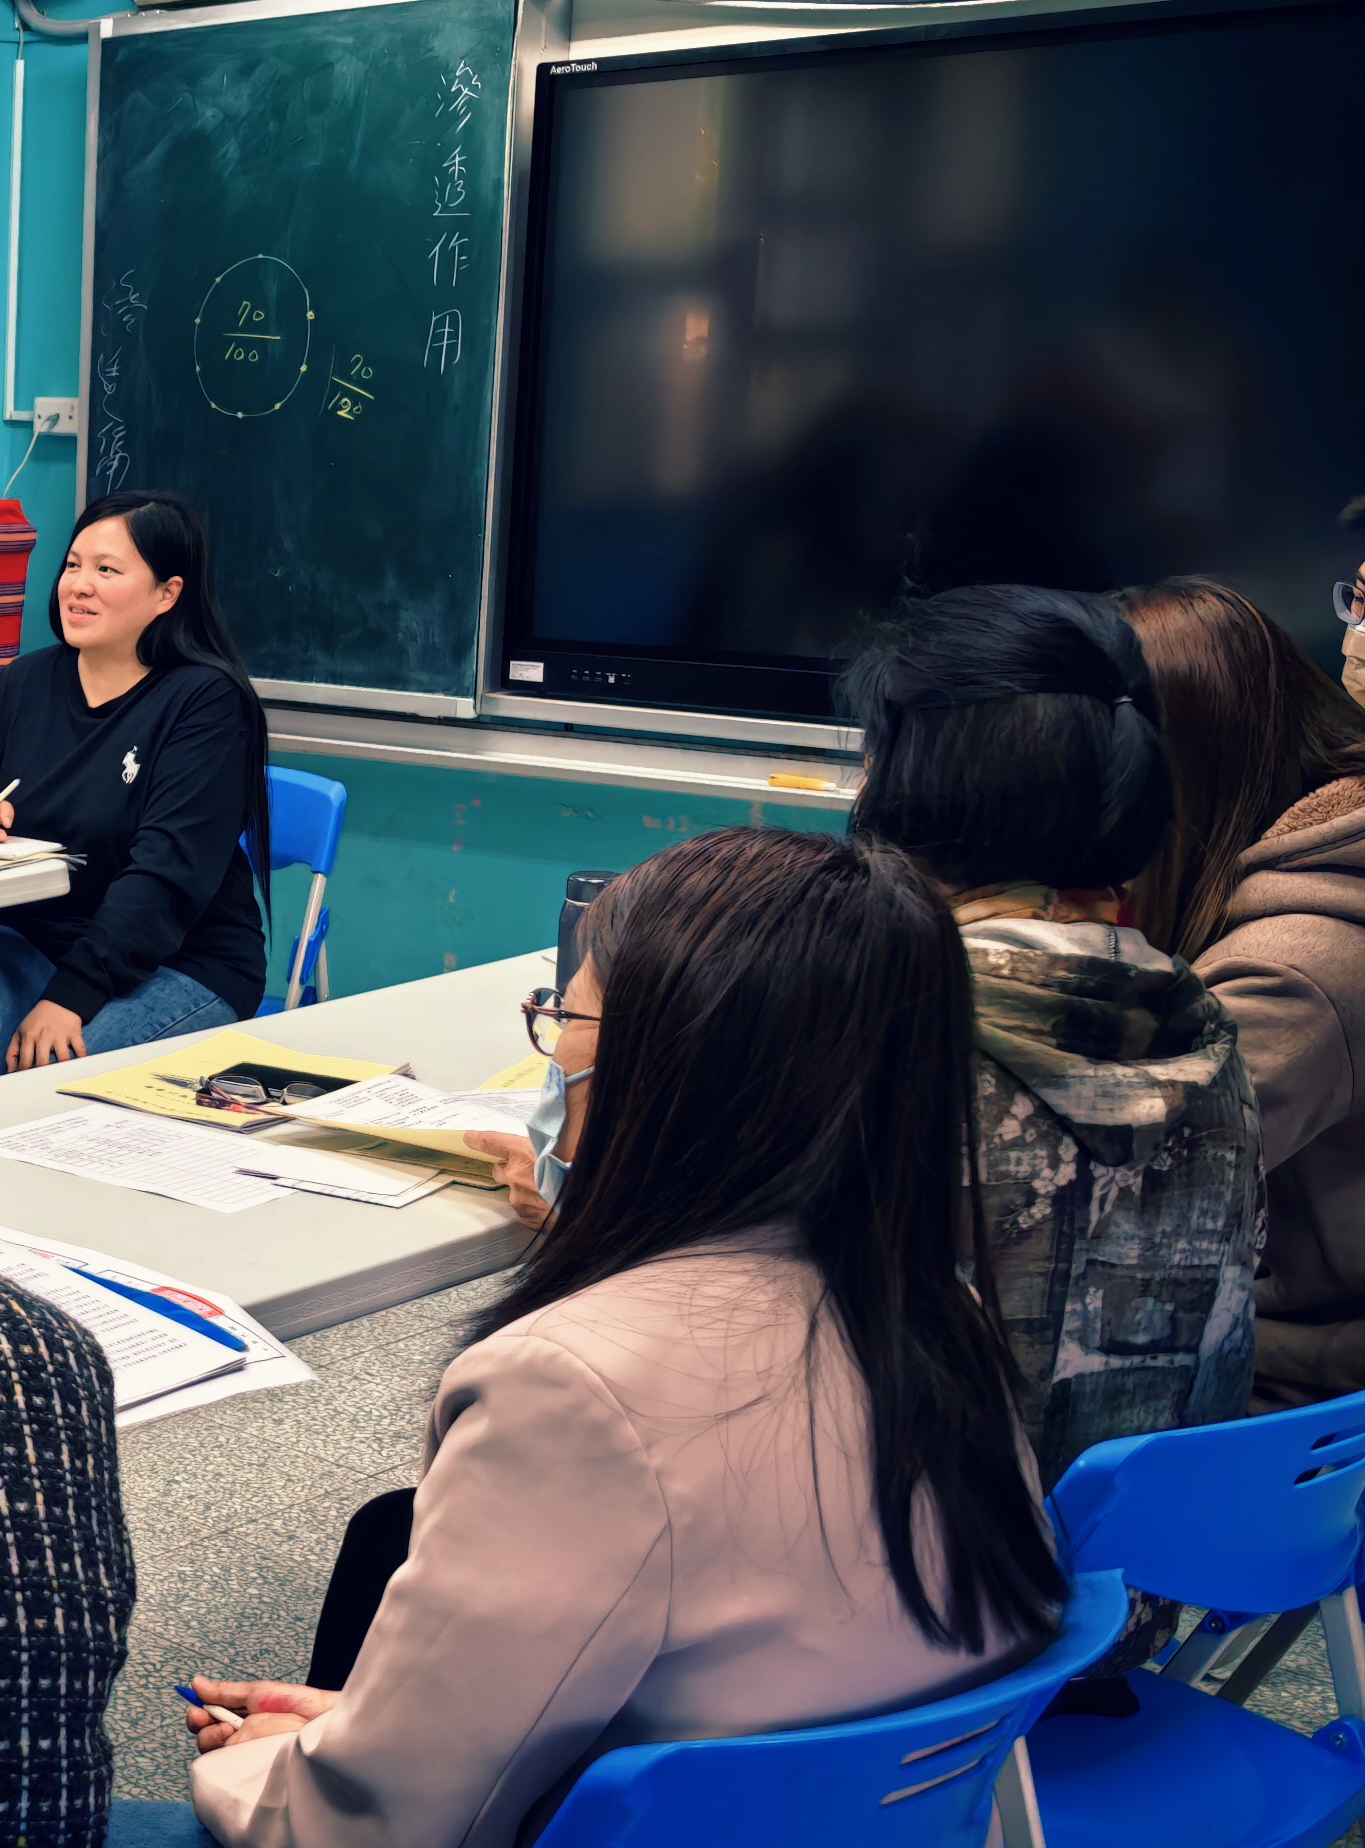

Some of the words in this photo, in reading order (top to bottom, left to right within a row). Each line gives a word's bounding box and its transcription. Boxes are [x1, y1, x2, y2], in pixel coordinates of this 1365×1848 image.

[550, 61, 598, 75] AeroTouch
[423, 59, 481, 375] 滲透作用
[237, 300, 265, 328] 70
[224, 341, 259, 362] 100
[350, 353, 373, 379] 70
[327, 390, 363, 421] 120
